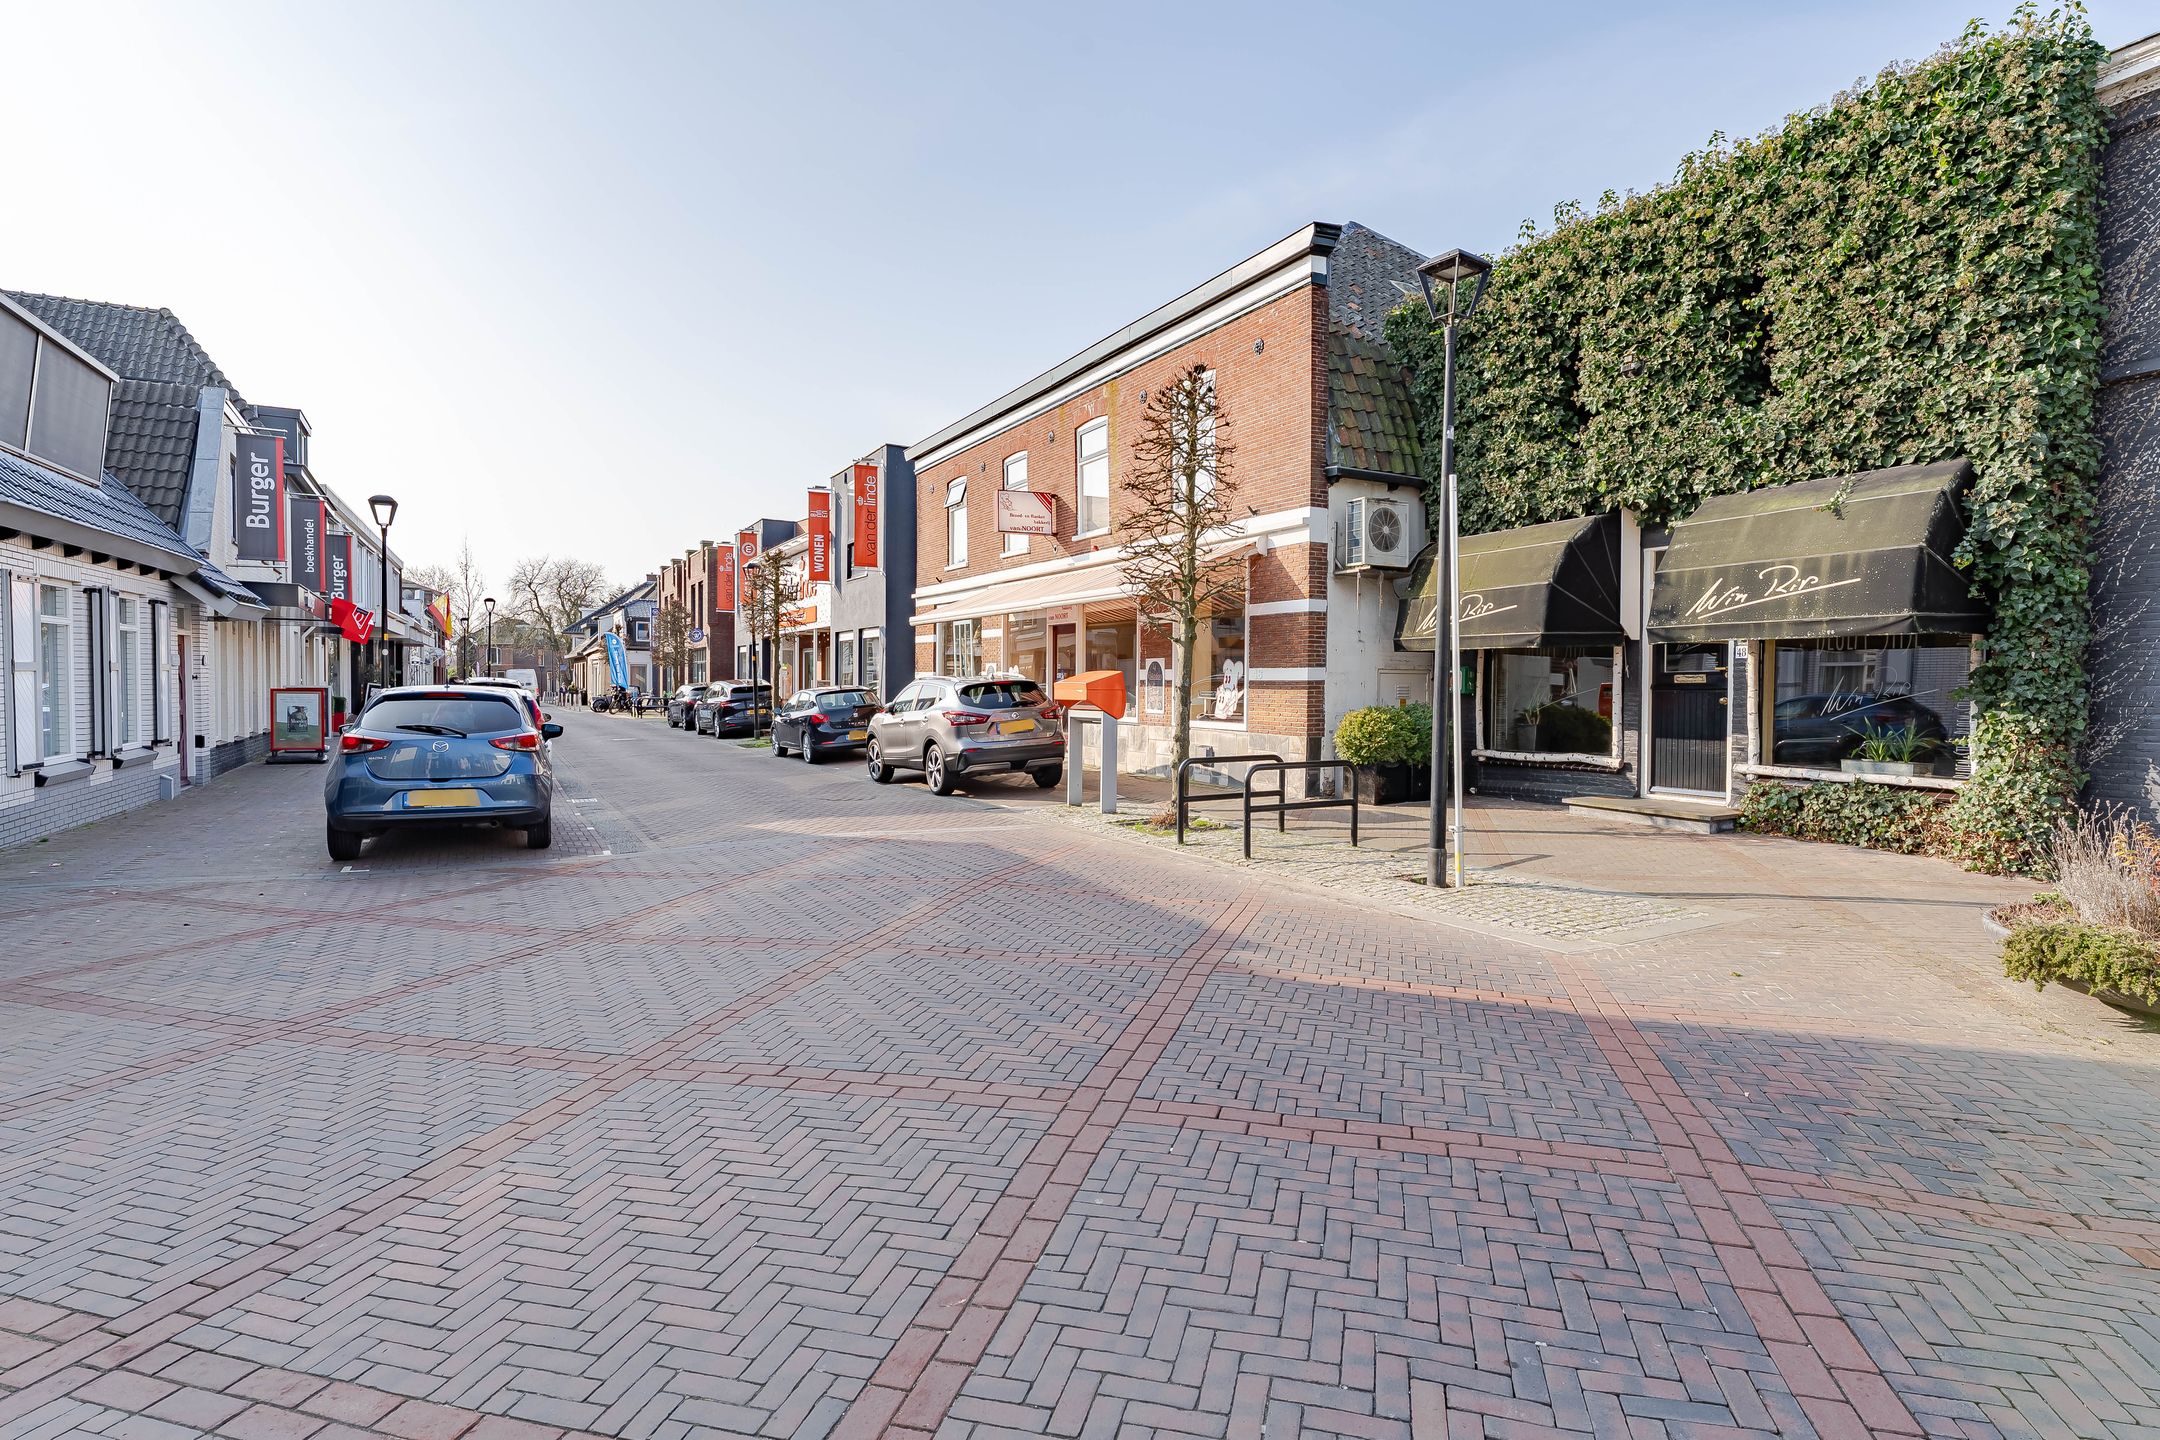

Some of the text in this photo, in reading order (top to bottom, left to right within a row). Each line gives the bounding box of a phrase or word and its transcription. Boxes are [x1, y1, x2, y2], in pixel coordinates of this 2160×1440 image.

[246, 451, 275, 529] Burger
[864, 475, 877, 557] van der linde
[304, 518, 315, 573] boekhandel
[723, 552, 733, 572] linde
[814, 534, 825, 573] WONEN
[331, 555, 348, 600] Burger
[723, 573, 733, 587] der
[1736, 646, 1747, 658] 48
